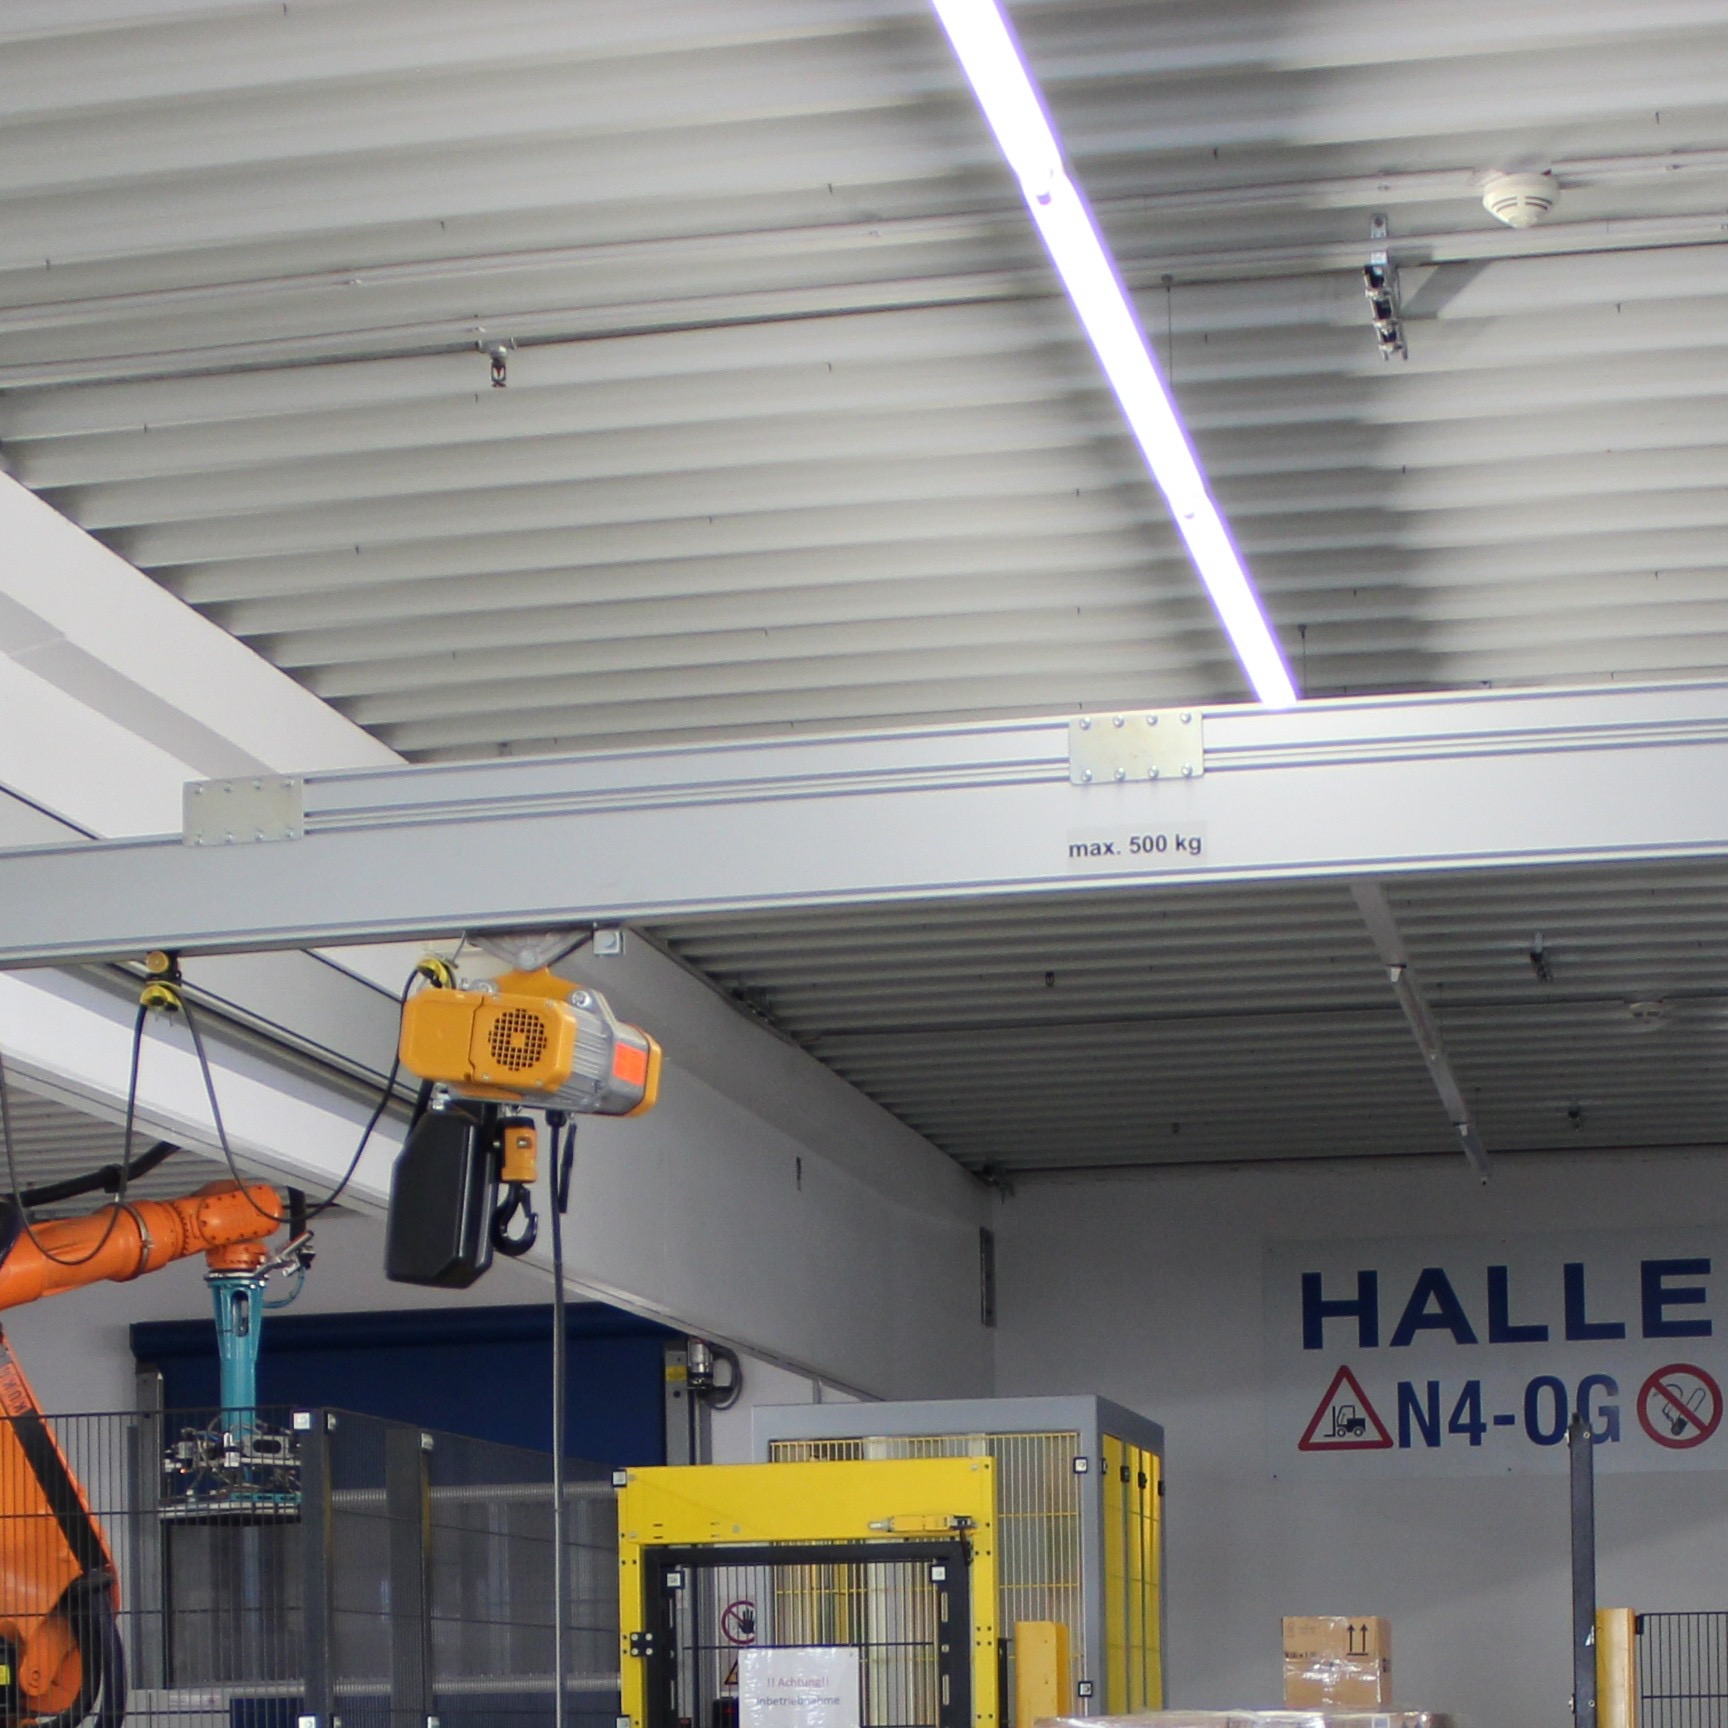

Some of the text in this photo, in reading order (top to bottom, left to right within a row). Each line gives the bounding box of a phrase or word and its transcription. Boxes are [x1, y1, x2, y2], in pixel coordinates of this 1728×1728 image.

[1069, 833, 1202, 858] max. 500 kg
[1301, 1258, 1713, 1350] HALLE
